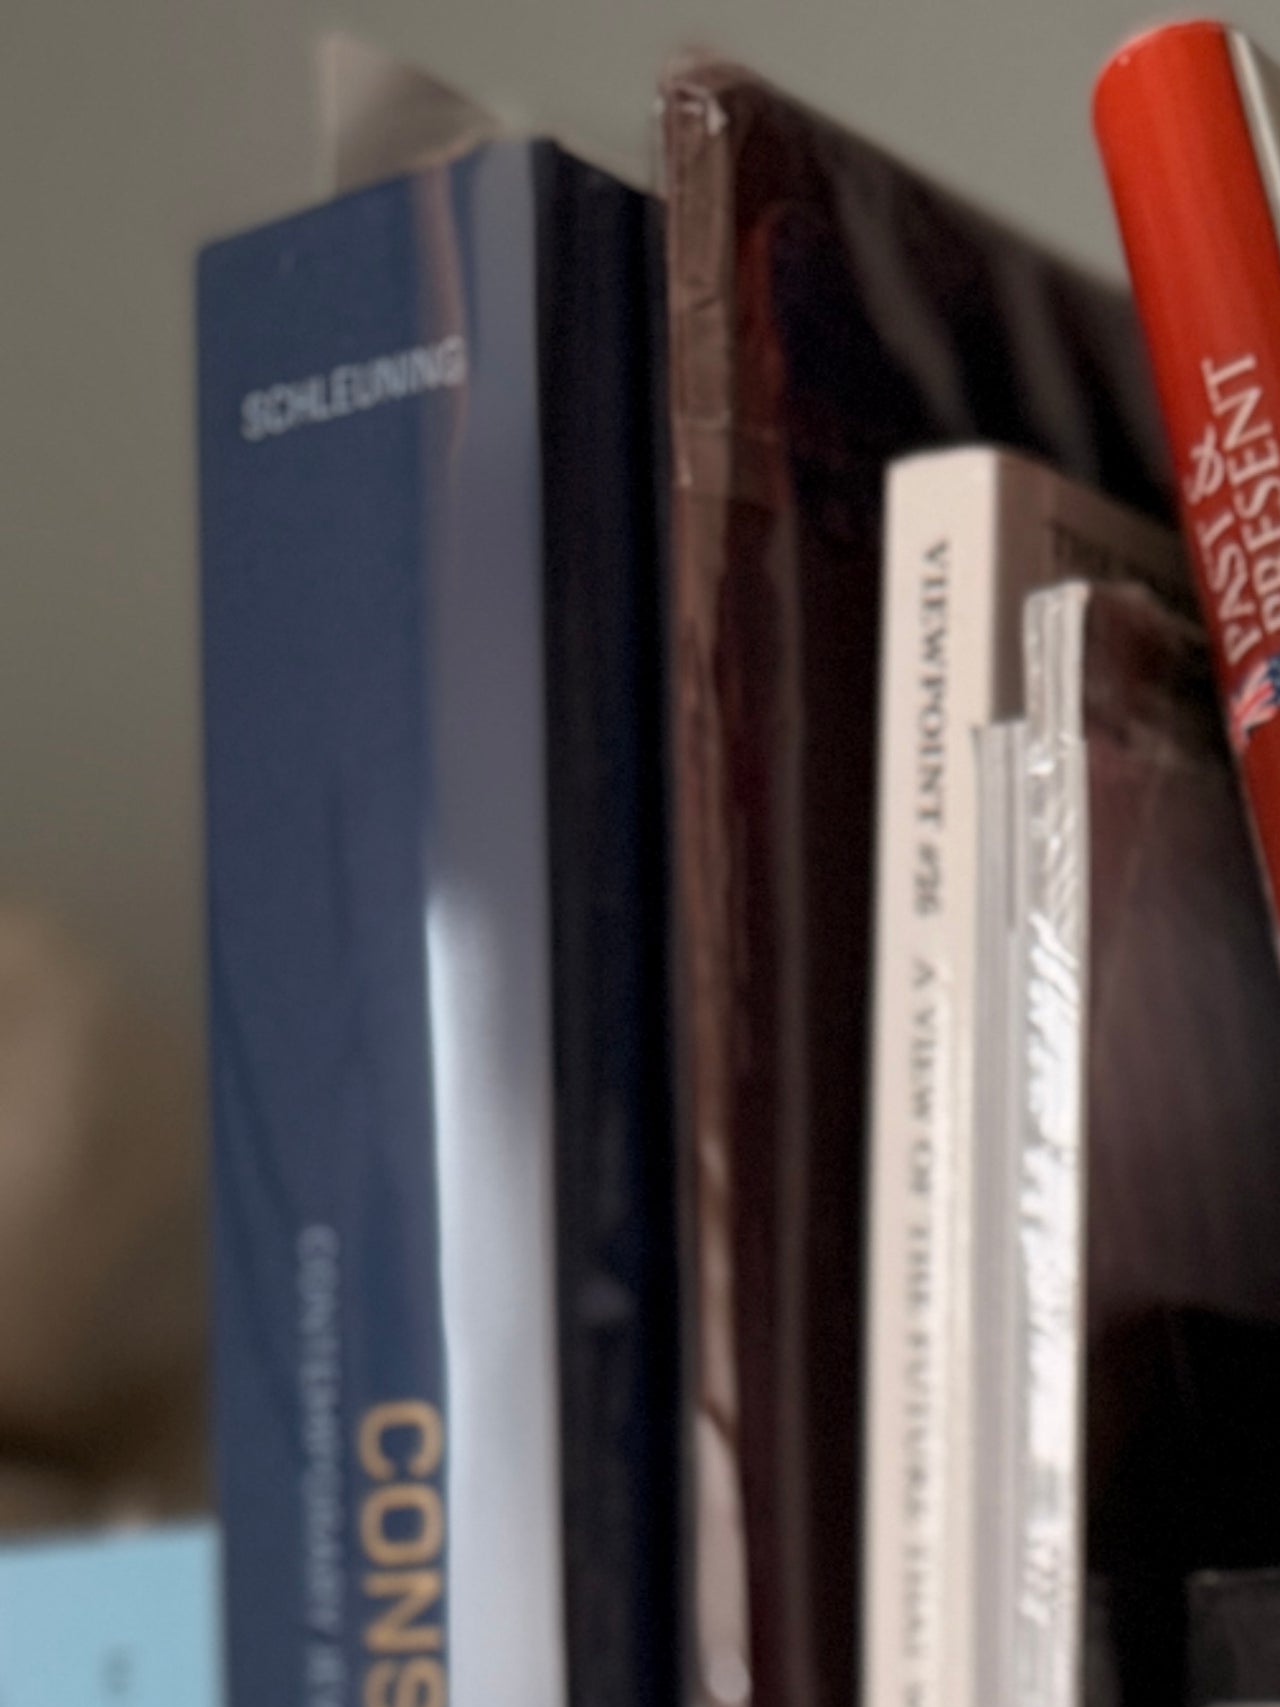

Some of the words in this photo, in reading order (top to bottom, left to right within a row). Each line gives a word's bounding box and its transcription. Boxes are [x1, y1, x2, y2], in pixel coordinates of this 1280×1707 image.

[240, 334, 468, 442] SCHLEUNING
[1184, 424, 1224, 507] &
[1196, 504, 1264, 665] PAST
[914, 540, 951, 832] VIEWPOINT
[909, 1002, 937, 1121] VIEW
